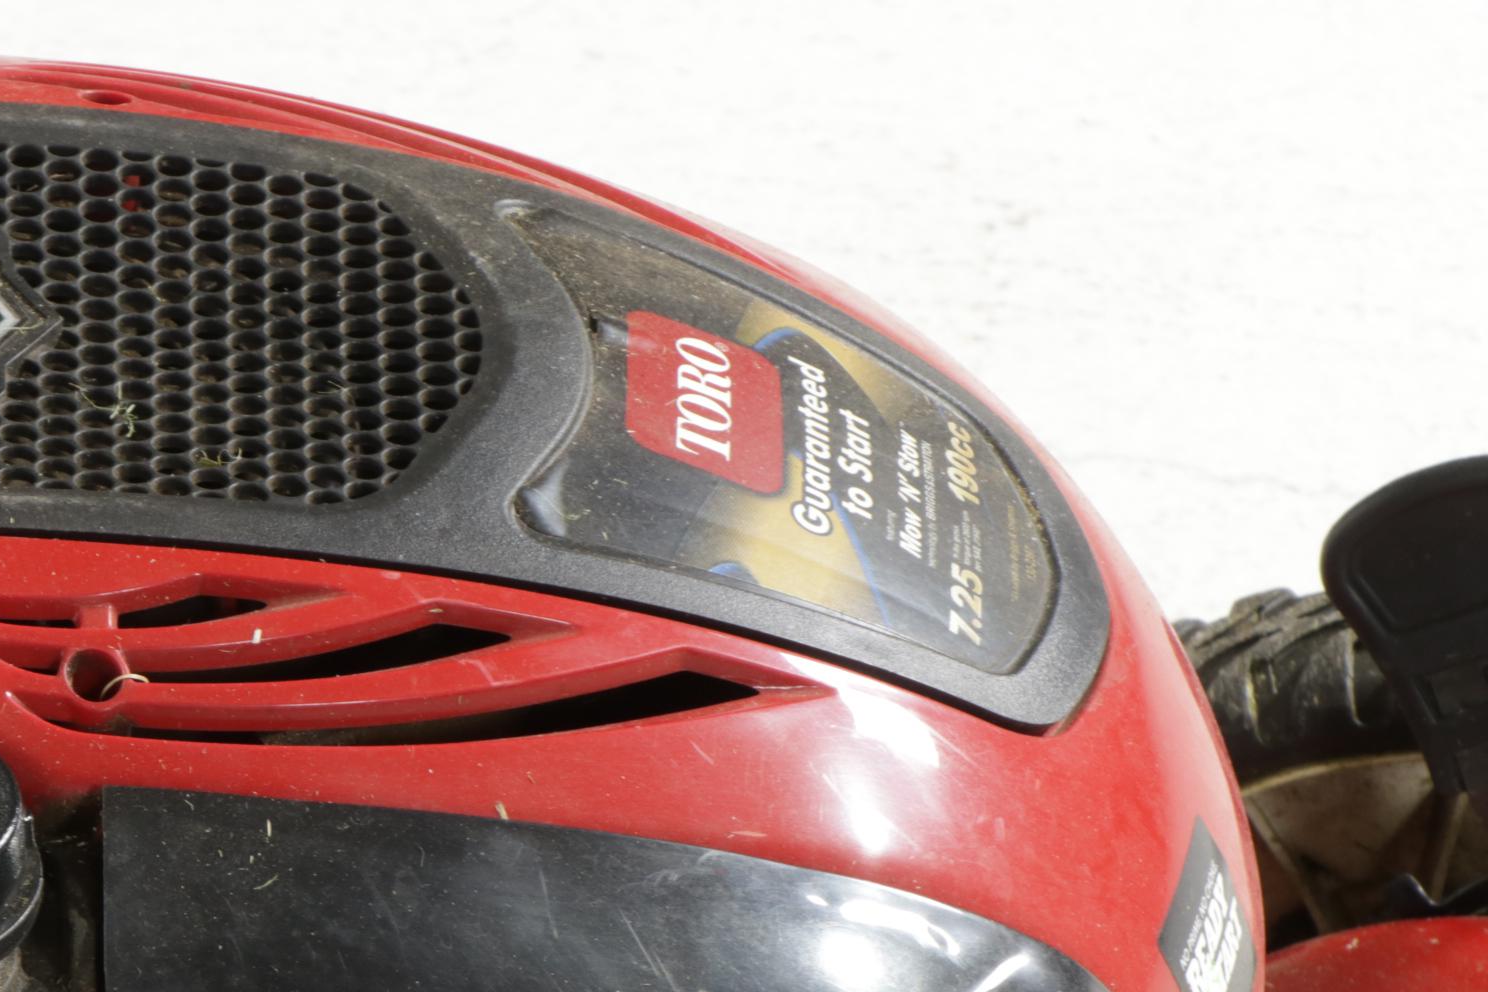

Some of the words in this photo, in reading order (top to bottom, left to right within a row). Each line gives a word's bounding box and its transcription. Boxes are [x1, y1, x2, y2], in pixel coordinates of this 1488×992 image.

[675, 337, 732, 462] TORO
[787, 355, 832, 535] Guaranteed
[837, 408, 874, 484] Start
[945, 421, 981, 505] 190cc
[841, 486, 874, 520] to
[898, 507, 923, 559] Mow
[948, 562, 983, 646] 7.25
